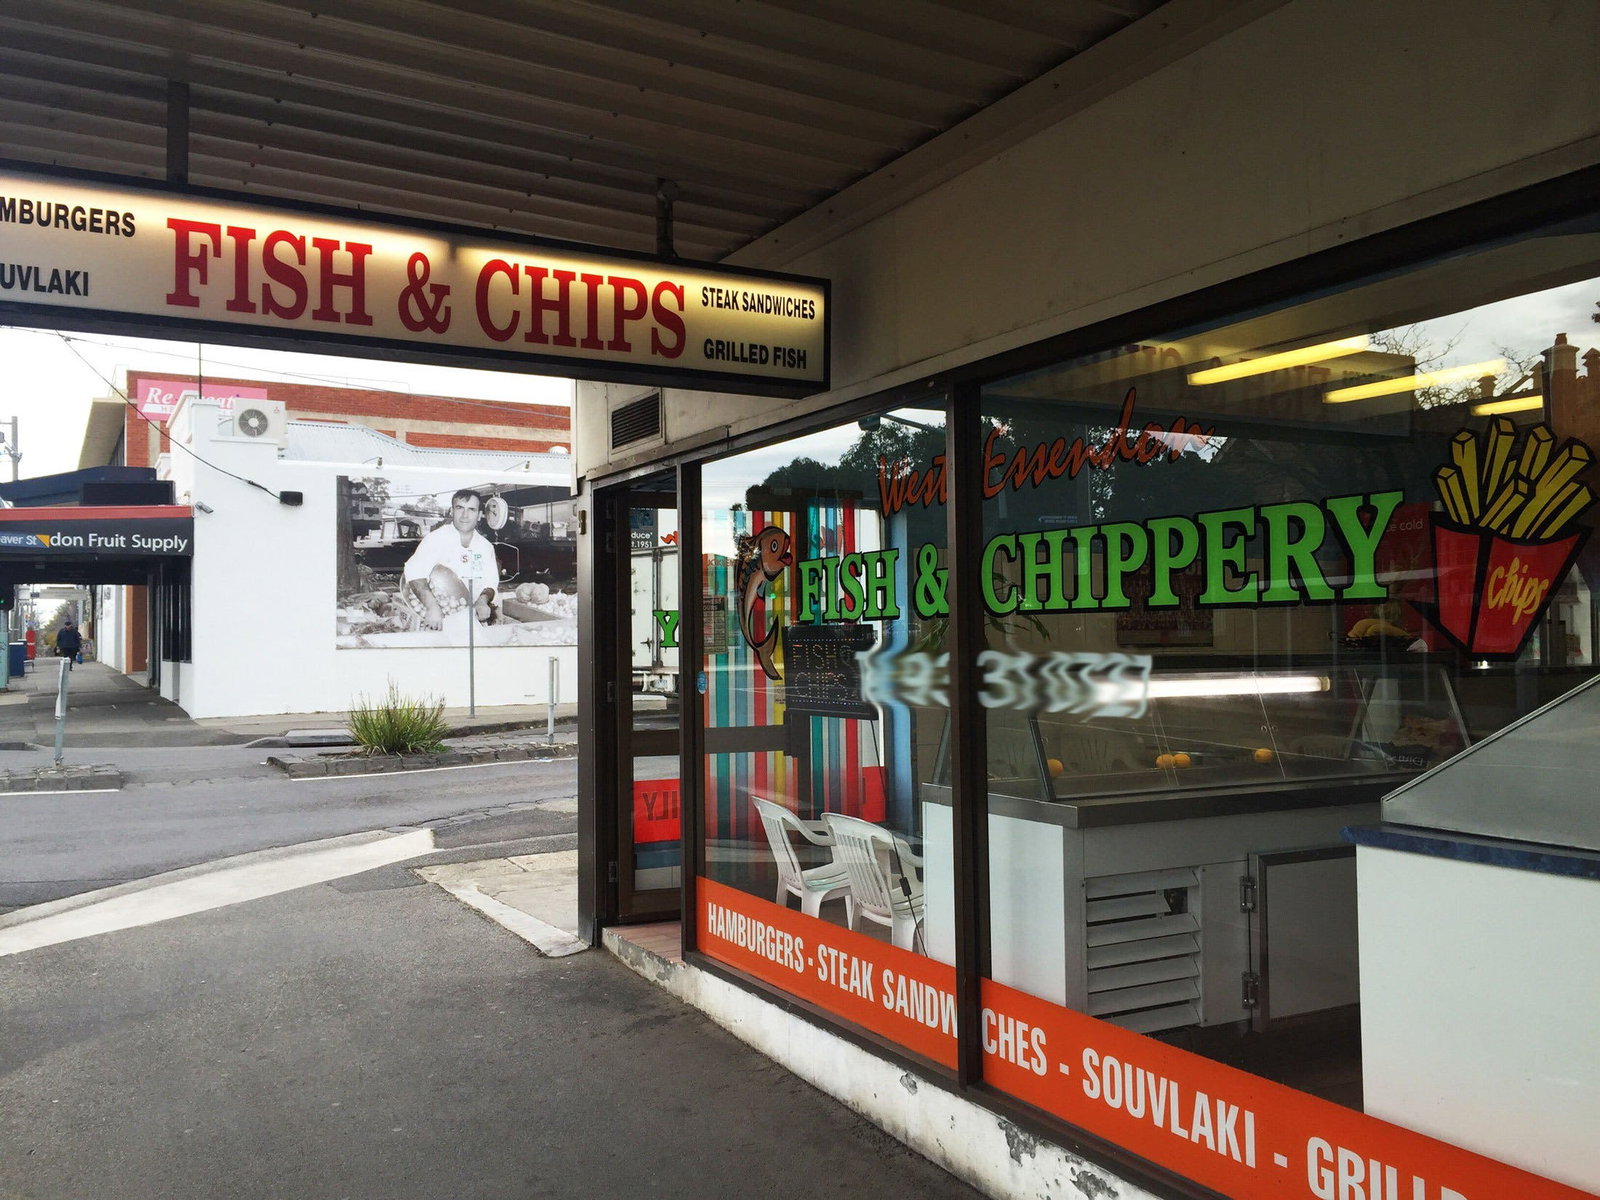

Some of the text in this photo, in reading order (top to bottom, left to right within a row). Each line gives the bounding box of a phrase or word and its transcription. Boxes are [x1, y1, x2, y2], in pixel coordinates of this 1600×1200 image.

[0, 197, 135, 238] MBURGERS
[166, 218, 686, 359] FISH & CHIPS
[702, 286, 816, 320] STEAK SANDWICHES
[704, 338, 807, 369] GRILLED FISH
[879, 388, 1215, 518] West Essendon
[0, 535, 37, 545] aver St
[88, 533, 127, 548] Fruit
[132, 534, 188, 552] Supply
[799, 548, 901, 622] FISH
[914, 543, 949, 620] &
[980, 490, 1404, 617] CHIPPERY
[1488, 557, 1549, 625] Chips
[708, 902, 804, 974] HAMBURGERS
[817, 944, 874, 1002] STEAK
[882, 968, 1048, 1077] SANDWCHES
[1082, 1047, 1256, 1169] SOUVLAKI
